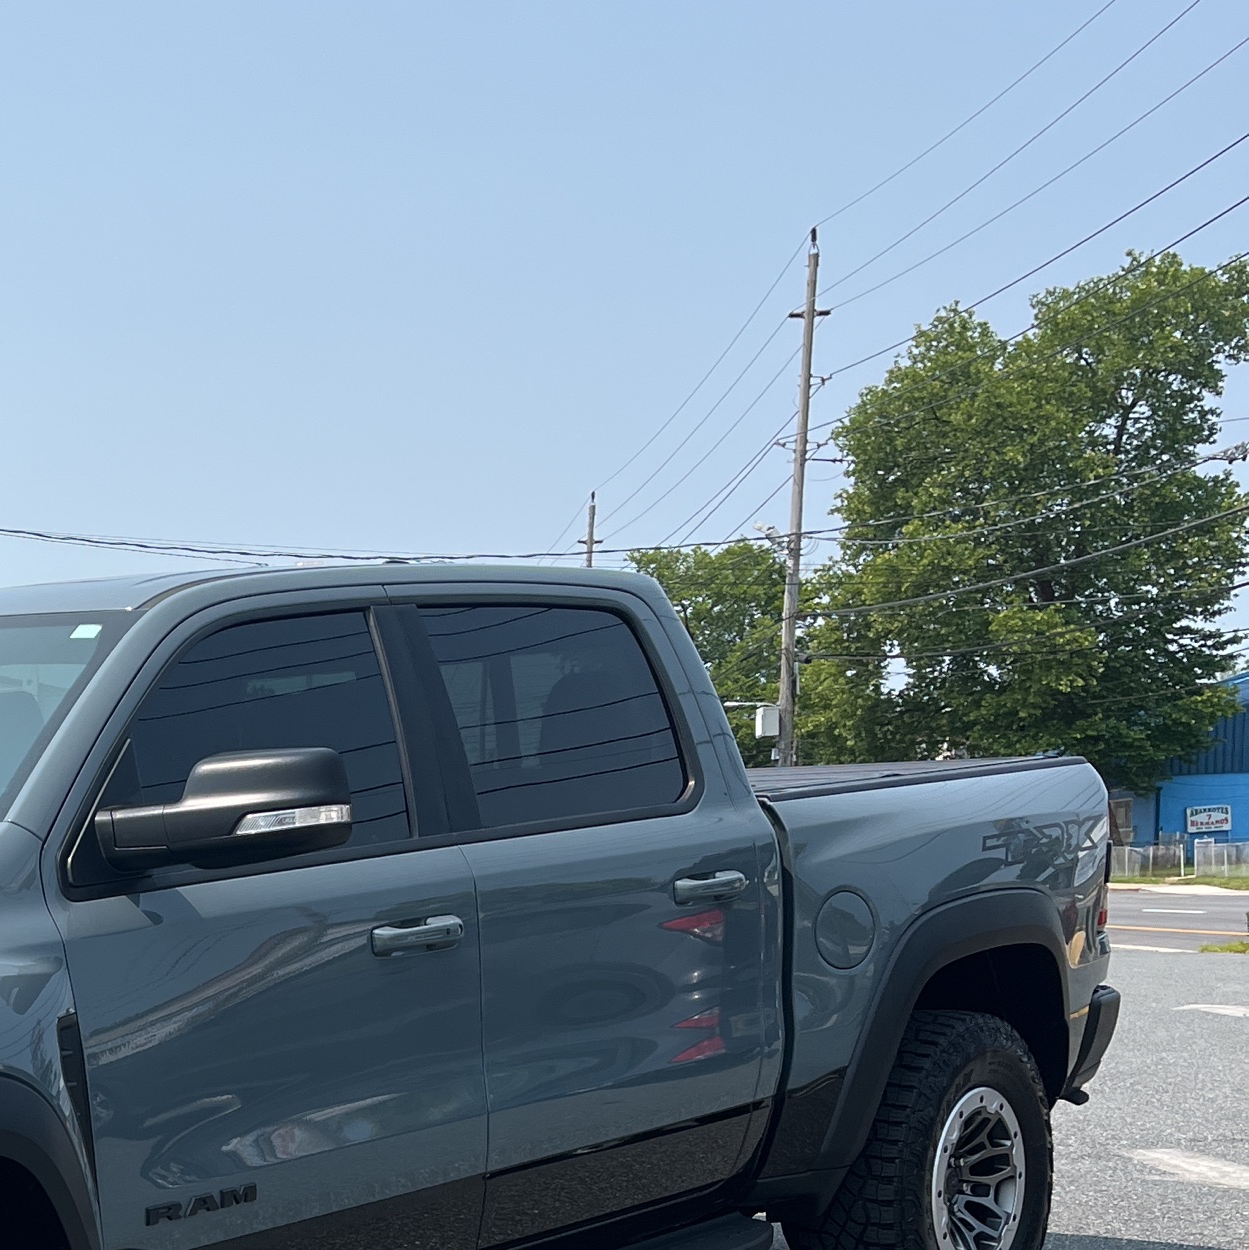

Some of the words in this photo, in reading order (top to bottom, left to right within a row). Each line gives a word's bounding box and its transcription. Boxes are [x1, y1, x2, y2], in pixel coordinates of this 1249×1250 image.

[982, 814, 1105, 867] TRX
[1190, 817, 1229, 826] HERMANOS
[145, 1182, 257, 1227] RAM
